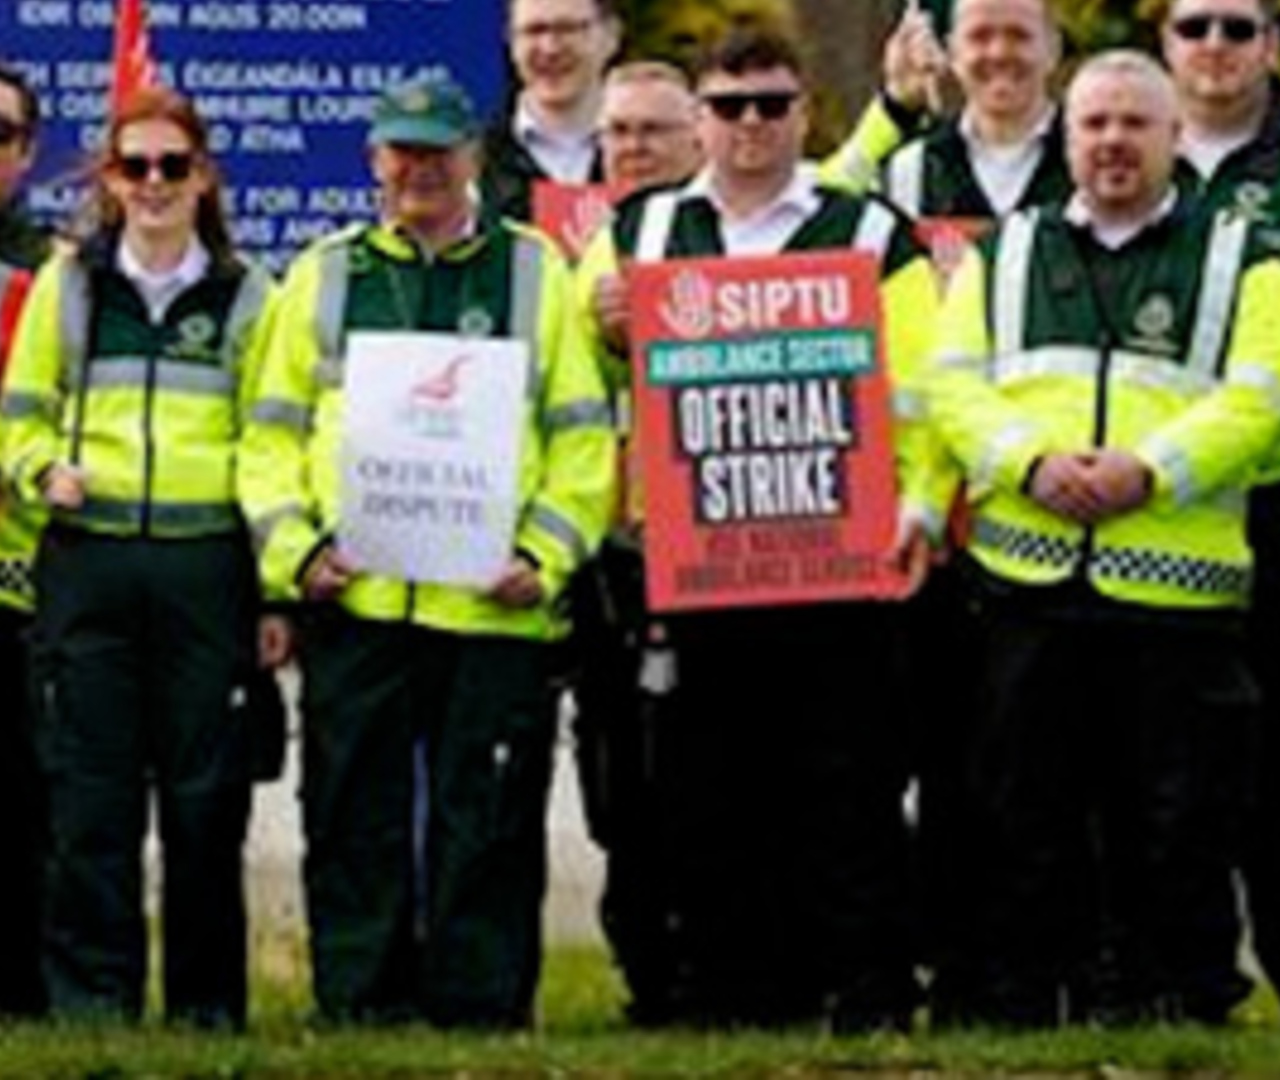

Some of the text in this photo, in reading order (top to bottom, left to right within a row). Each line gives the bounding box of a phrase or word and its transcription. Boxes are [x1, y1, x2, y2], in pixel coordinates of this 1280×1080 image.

[188, 2, 260, 29] AGUS
[245, 185, 301, 215] FOR
[719, 276, 852, 331] SIPTU
[651, 334, 871, 380] AMBULANCE SECTOR
[677, 377, 853, 455] OFFICIAL
[700, 448, 842, 521] STRIKE
